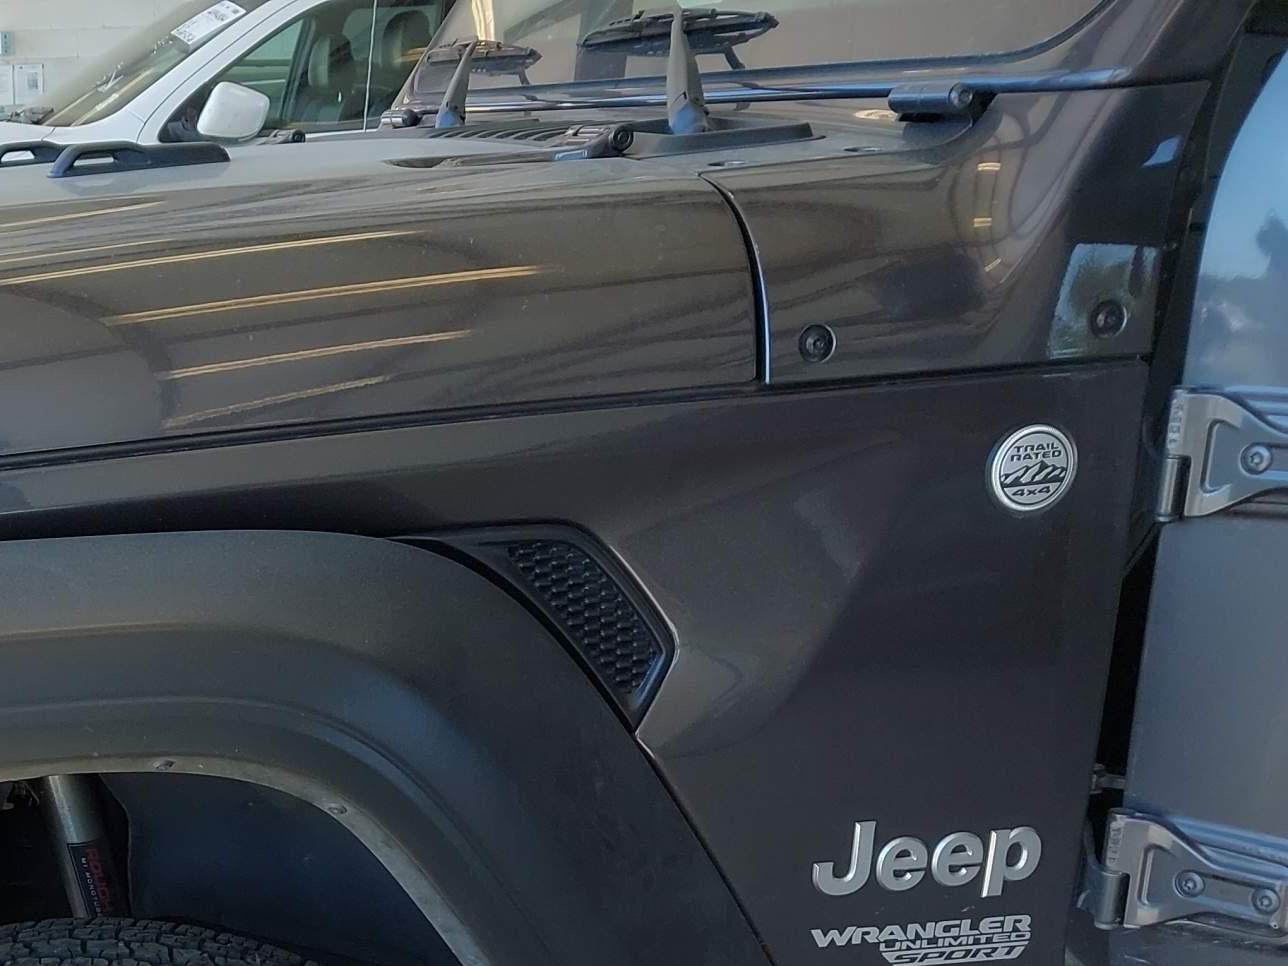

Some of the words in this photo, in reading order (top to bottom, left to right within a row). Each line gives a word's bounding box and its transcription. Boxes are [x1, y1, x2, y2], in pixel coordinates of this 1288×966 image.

[1010, 449, 1062, 462] RATED
[1014, 442, 1059, 453] TRAIL
[812, 820, 1042, 898] Jeep
[811, 914, 1032, 948] WRANGLER
[879, 931, 1031, 951] UNLIMITED
[892, 945, 1027, 964] SPORT
